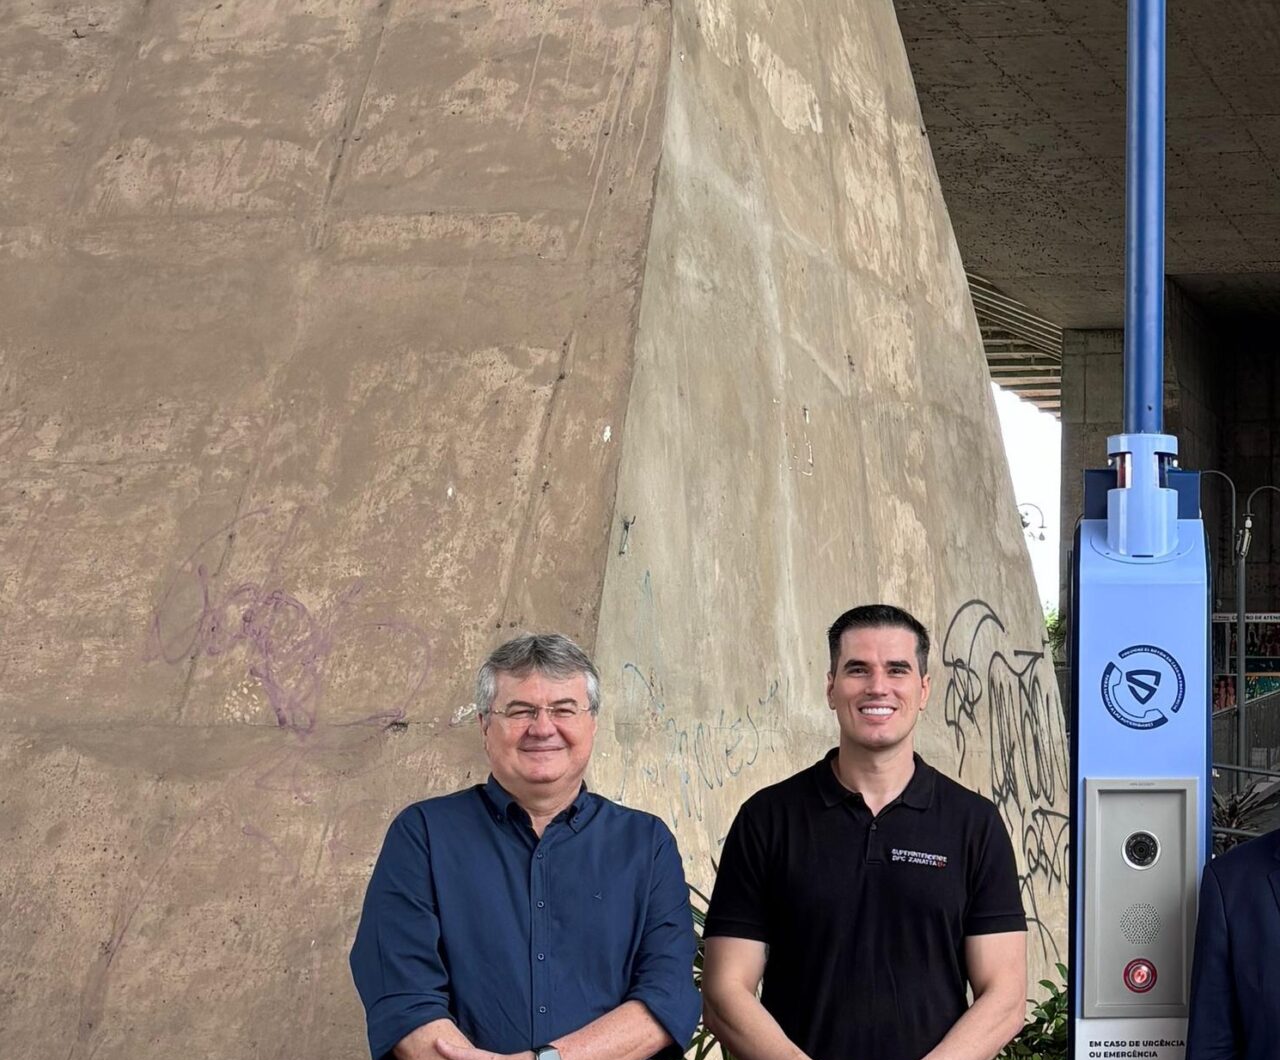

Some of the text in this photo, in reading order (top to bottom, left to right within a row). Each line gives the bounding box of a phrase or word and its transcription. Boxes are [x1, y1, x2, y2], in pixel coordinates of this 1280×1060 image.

[1089, 1039, 1185, 1048] EM CASO DE URGÊNCIA
[1104, 1050, 1158, 1058] EMERGÊNCIA
